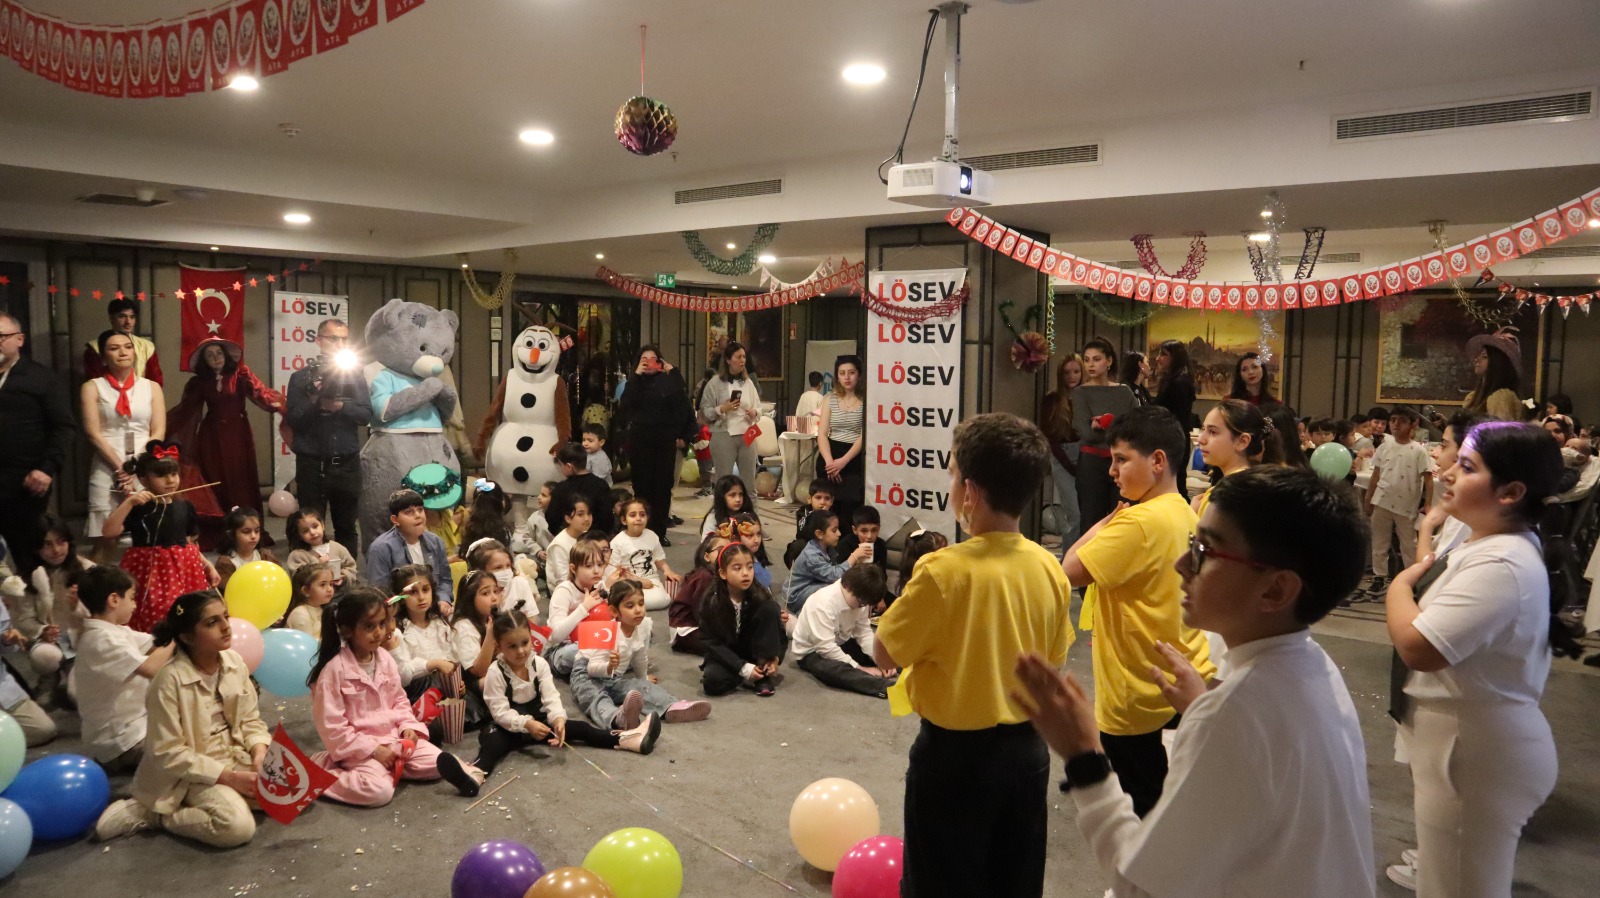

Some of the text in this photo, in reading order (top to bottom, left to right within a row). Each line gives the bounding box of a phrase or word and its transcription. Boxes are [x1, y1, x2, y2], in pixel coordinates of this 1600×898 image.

[353, 17, 369, 30] ATA
[291, 46, 305, 58] ATA
[325, 35, 340, 46] ATA
[268, 61, 282, 71] ATA
[879, 279, 955, 302] LÖSEV
[281, 298, 341, 316] LÖSEV
[281, 326, 316, 343] LÖS
[878, 320, 955, 343] LÖSEV
[878, 361, 955, 385] LÖSEV
[877, 402, 954, 427] LÖSEV
[877, 443, 951, 469] LÖSEV
[875, 483, 949, 511] LÖSEV
[296, 788, 322, 811] ATA
